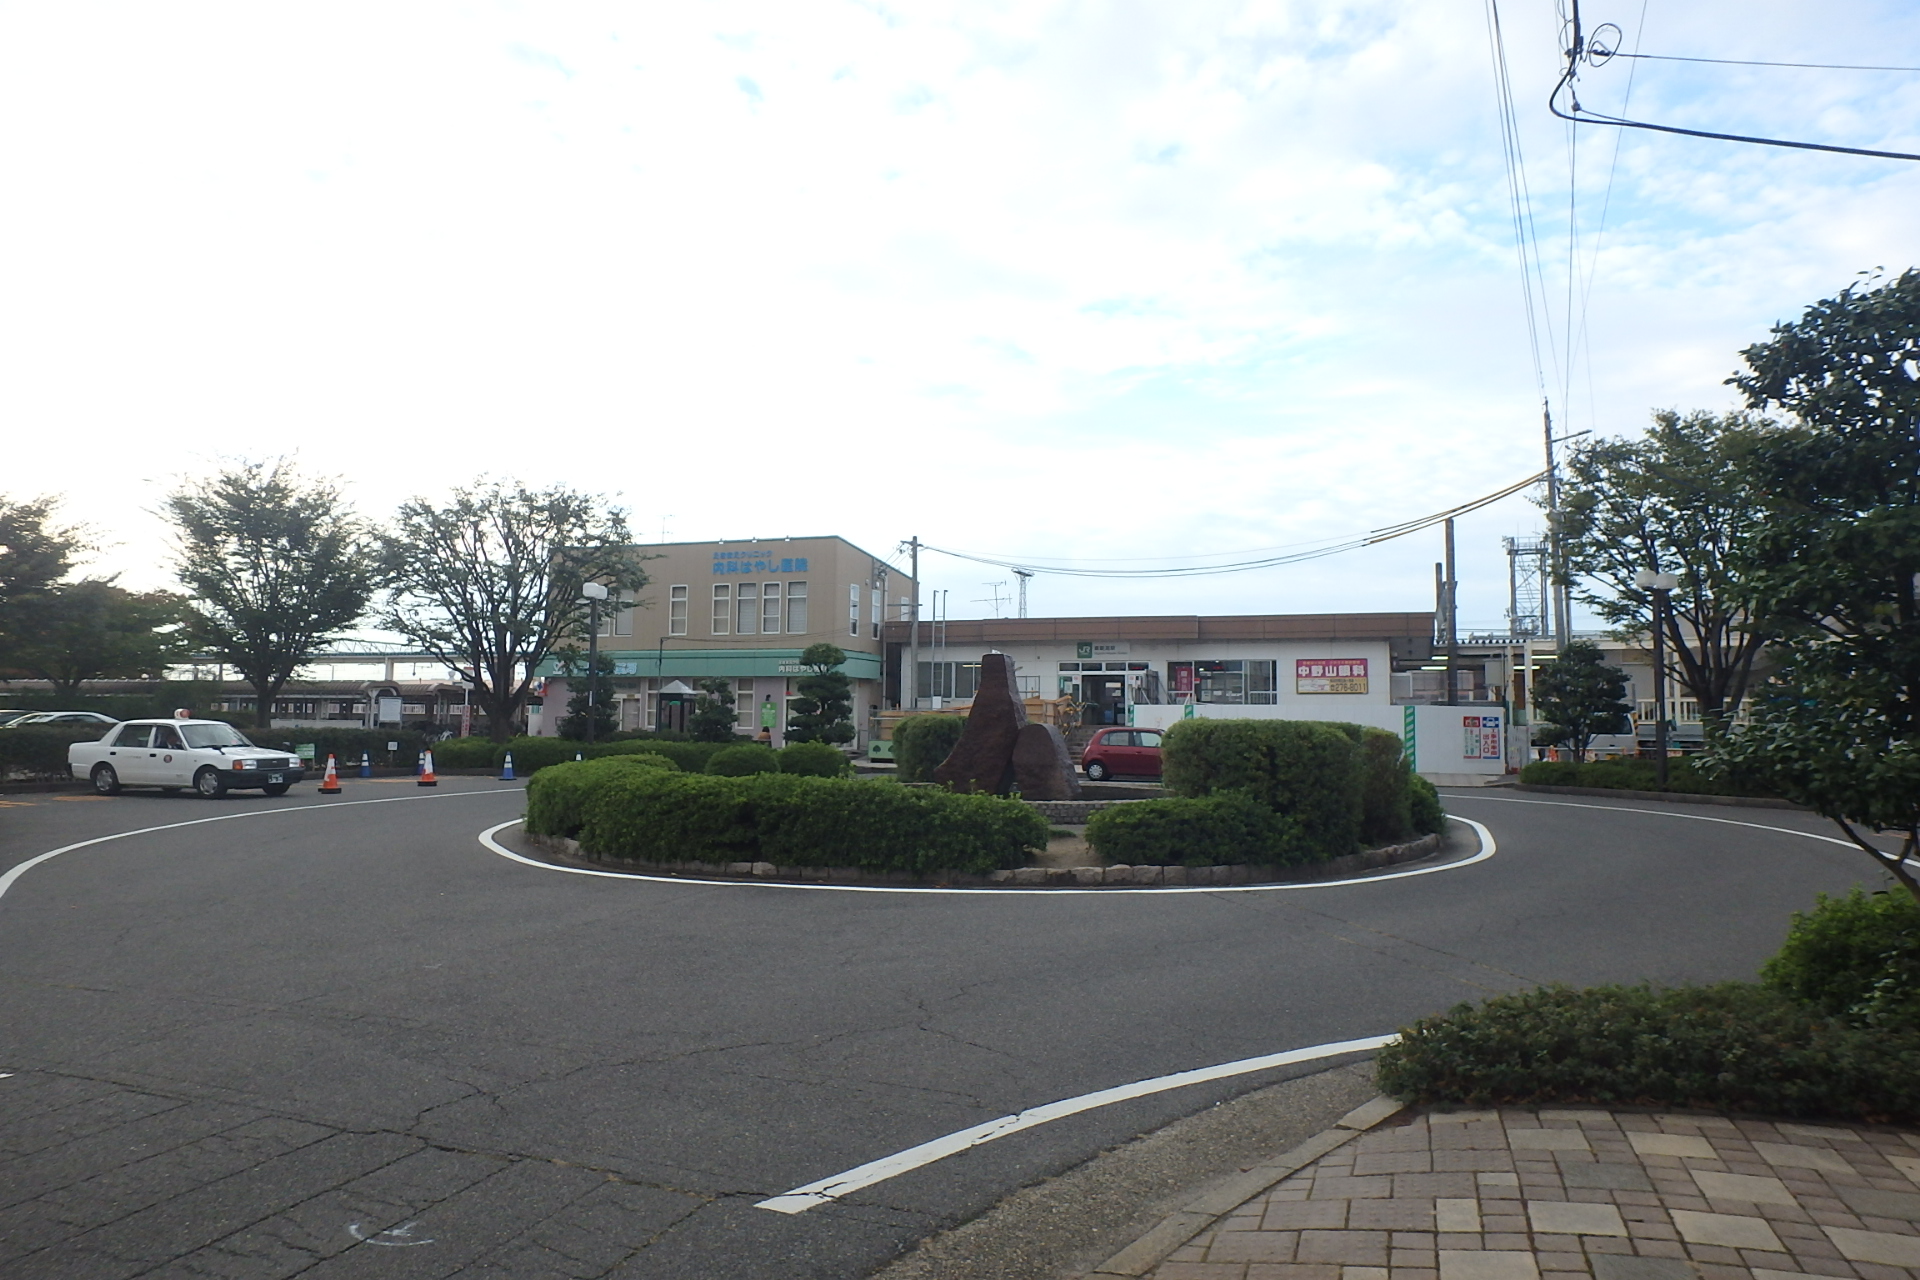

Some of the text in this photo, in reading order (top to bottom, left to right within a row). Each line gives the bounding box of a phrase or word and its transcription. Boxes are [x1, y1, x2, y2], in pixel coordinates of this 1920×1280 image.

[1298, 665, 1365, 676] 中野山眼科
